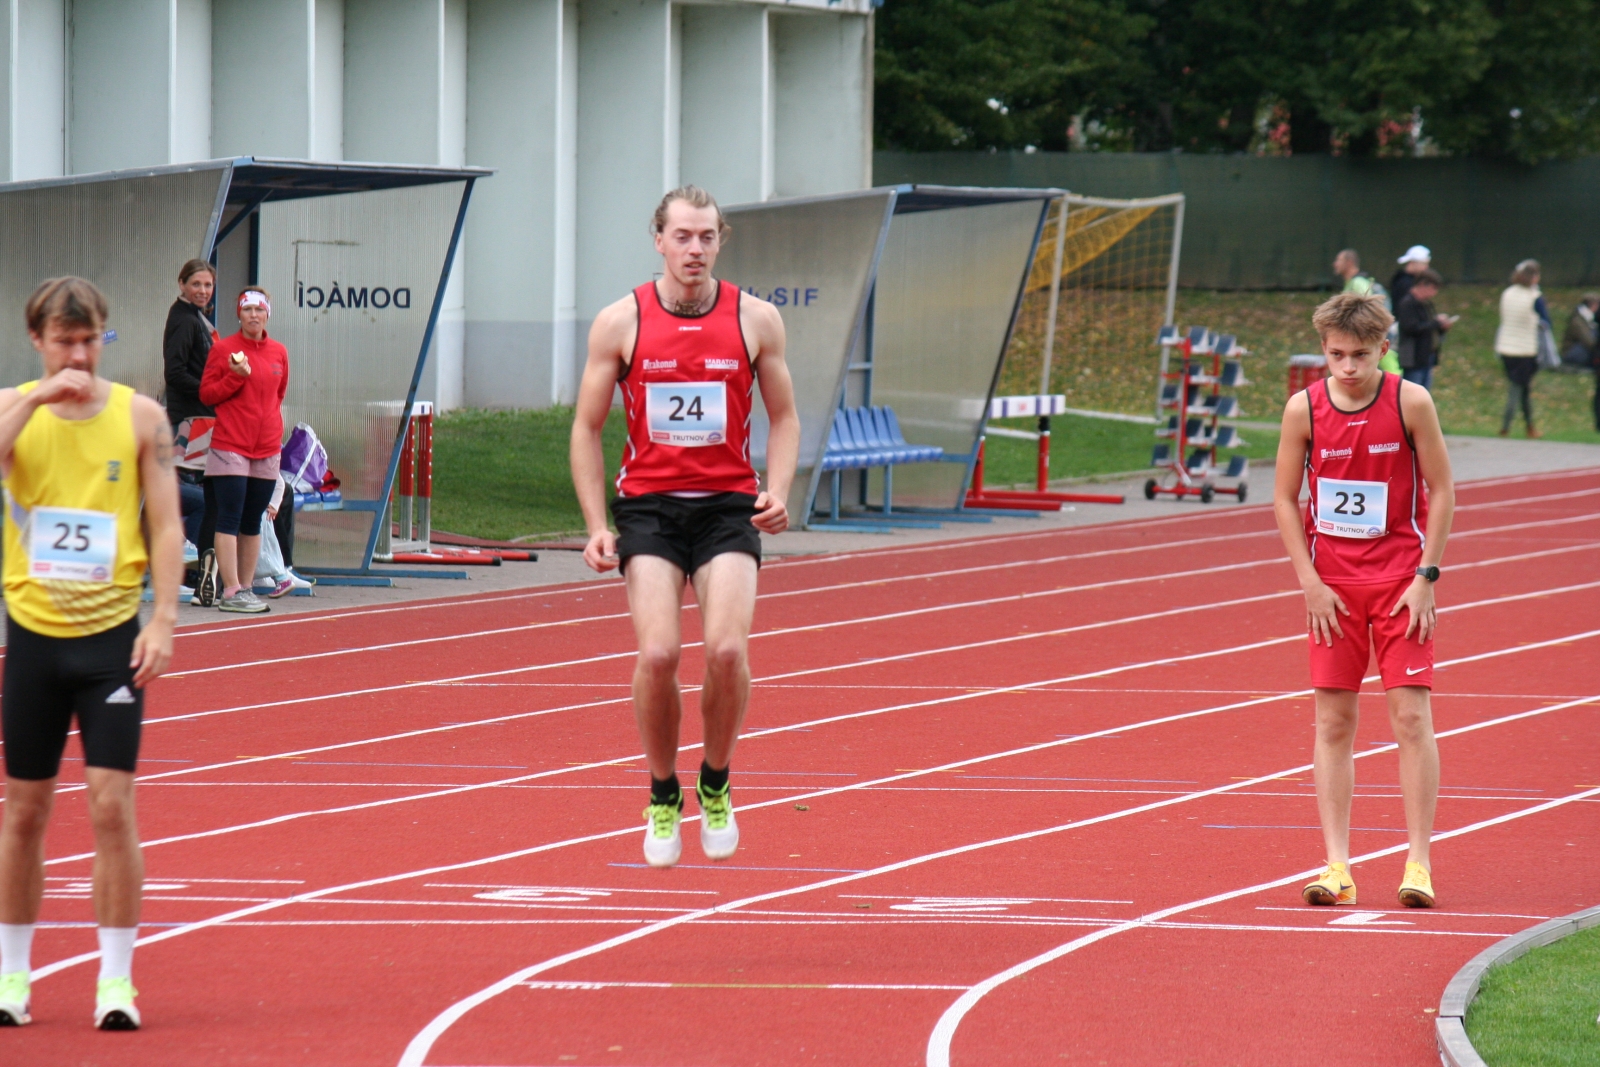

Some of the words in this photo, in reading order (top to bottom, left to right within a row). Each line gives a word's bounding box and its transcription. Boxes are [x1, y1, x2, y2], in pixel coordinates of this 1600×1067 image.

[704, 358, 739, 366] MARATON
[668, 395, 704, 421] 24
[672, 434, 705, 442] TRUTNOV
[1368, 442, 1400, 451] MARATON
[1334, 491, 1366, 516] 23
[1336, 525, 1366, 534] TRUTNOV
[52, 522, 91, 552] 25
